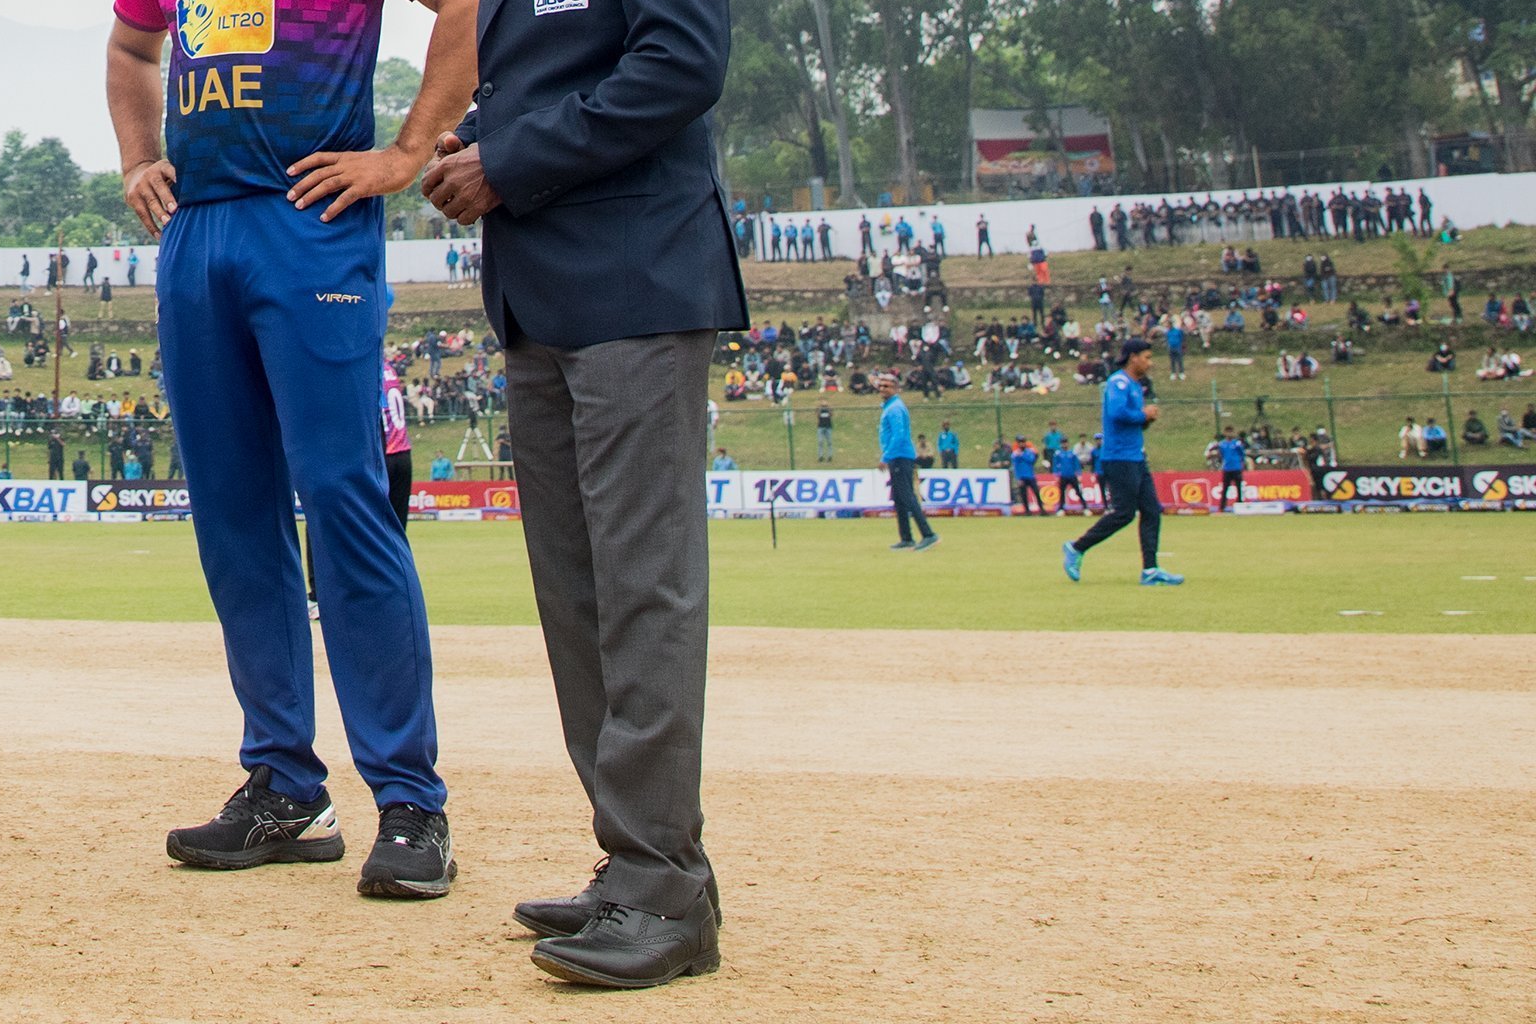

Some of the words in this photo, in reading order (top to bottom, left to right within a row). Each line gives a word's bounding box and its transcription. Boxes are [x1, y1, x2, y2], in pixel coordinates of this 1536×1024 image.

[217, 12, 265, 31] ILT20
[178, 65, 264, 116] UAE
[315, 293, 363, 304] VIRAT
[754, 478, 863, 503] 1XBAT
[1355, 476, 1462, 496] SKYEXCH
[1507, 475, 1536, 495] SK
[118, 489, 191, 507] SKYEXC
[408, 490, 471, 510] afaNEWS
